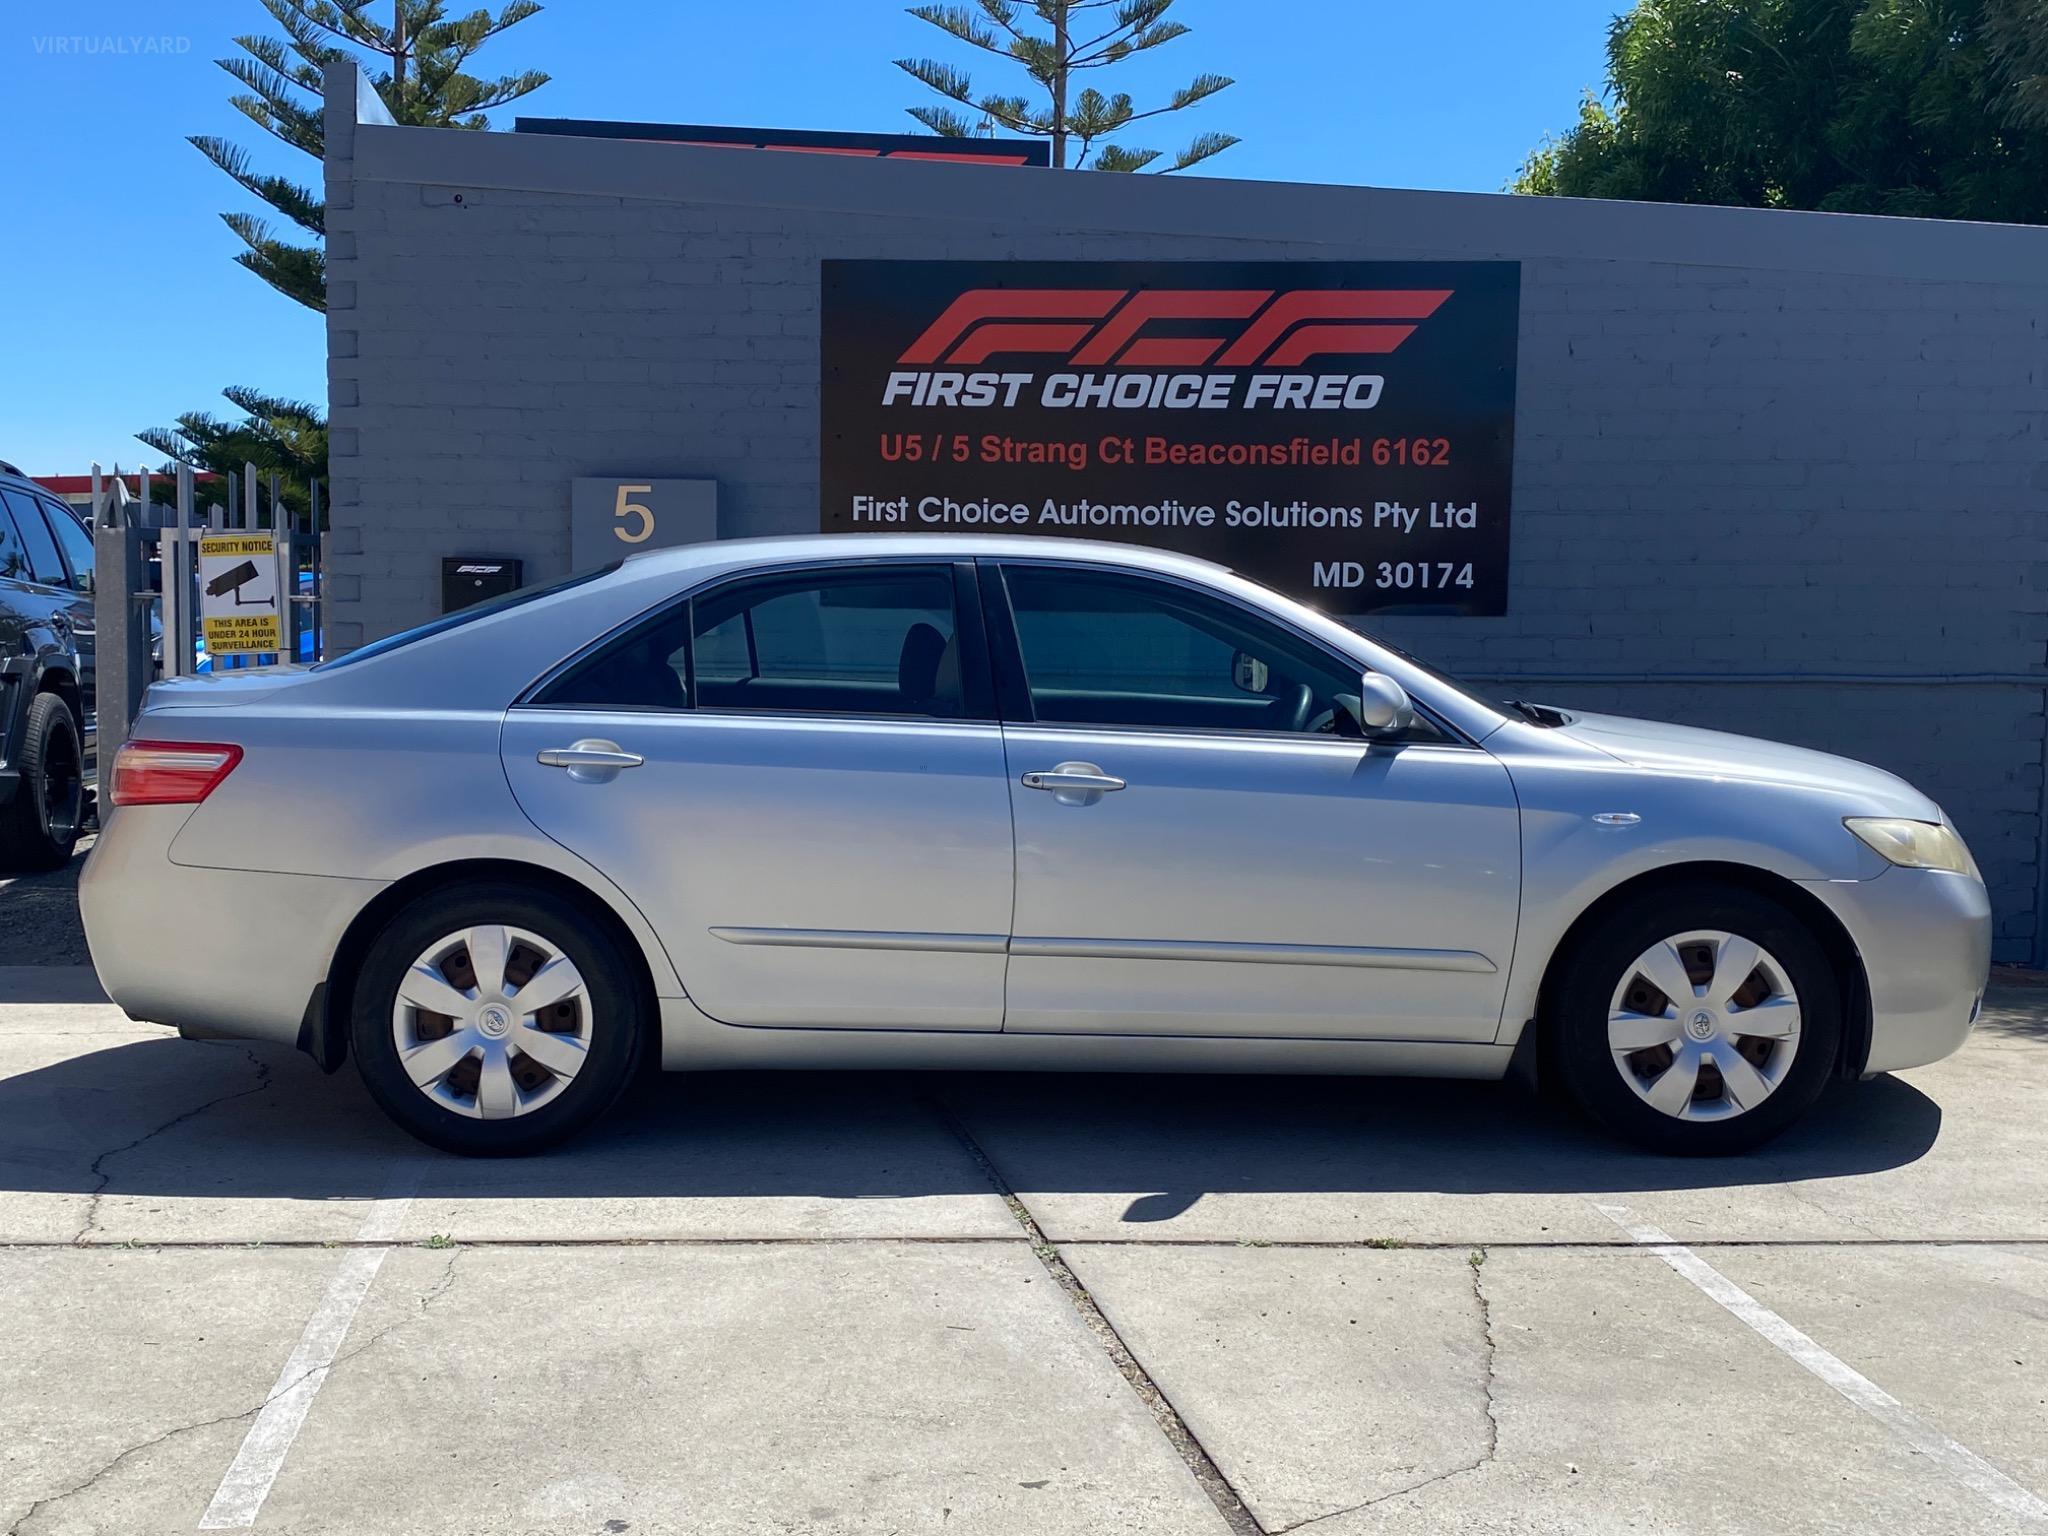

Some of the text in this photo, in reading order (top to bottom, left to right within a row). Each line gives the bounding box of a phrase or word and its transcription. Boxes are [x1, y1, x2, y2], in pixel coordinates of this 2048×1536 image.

[882, 371, 1385, 410] FIRST CHOICE FREO
[879, 434, 923, 463] U5
[951, 435, 971, 462] 5
[979, 435, 1088, 471] Strang
[1098, 436, 1135, 466] Ct
[1145, 436, 1361, 467] Beaconsfield
[1372, 438, 1451, 467] 6162
[613, 485, 655, 544] 5
[852, 495, 1478, 533] First Choice Automotive Solutions Pty Ltd
[202, 540, 273, 553] SECURITY NOTICE
[1312, 562, 1475, 590] MD 30174
[208, 629, 276, 639] UNDER 24 HOUR
[213, 618, 269, 628] THIS AREA IS
[211, 640, 274, 649] SURVEILLANCE
